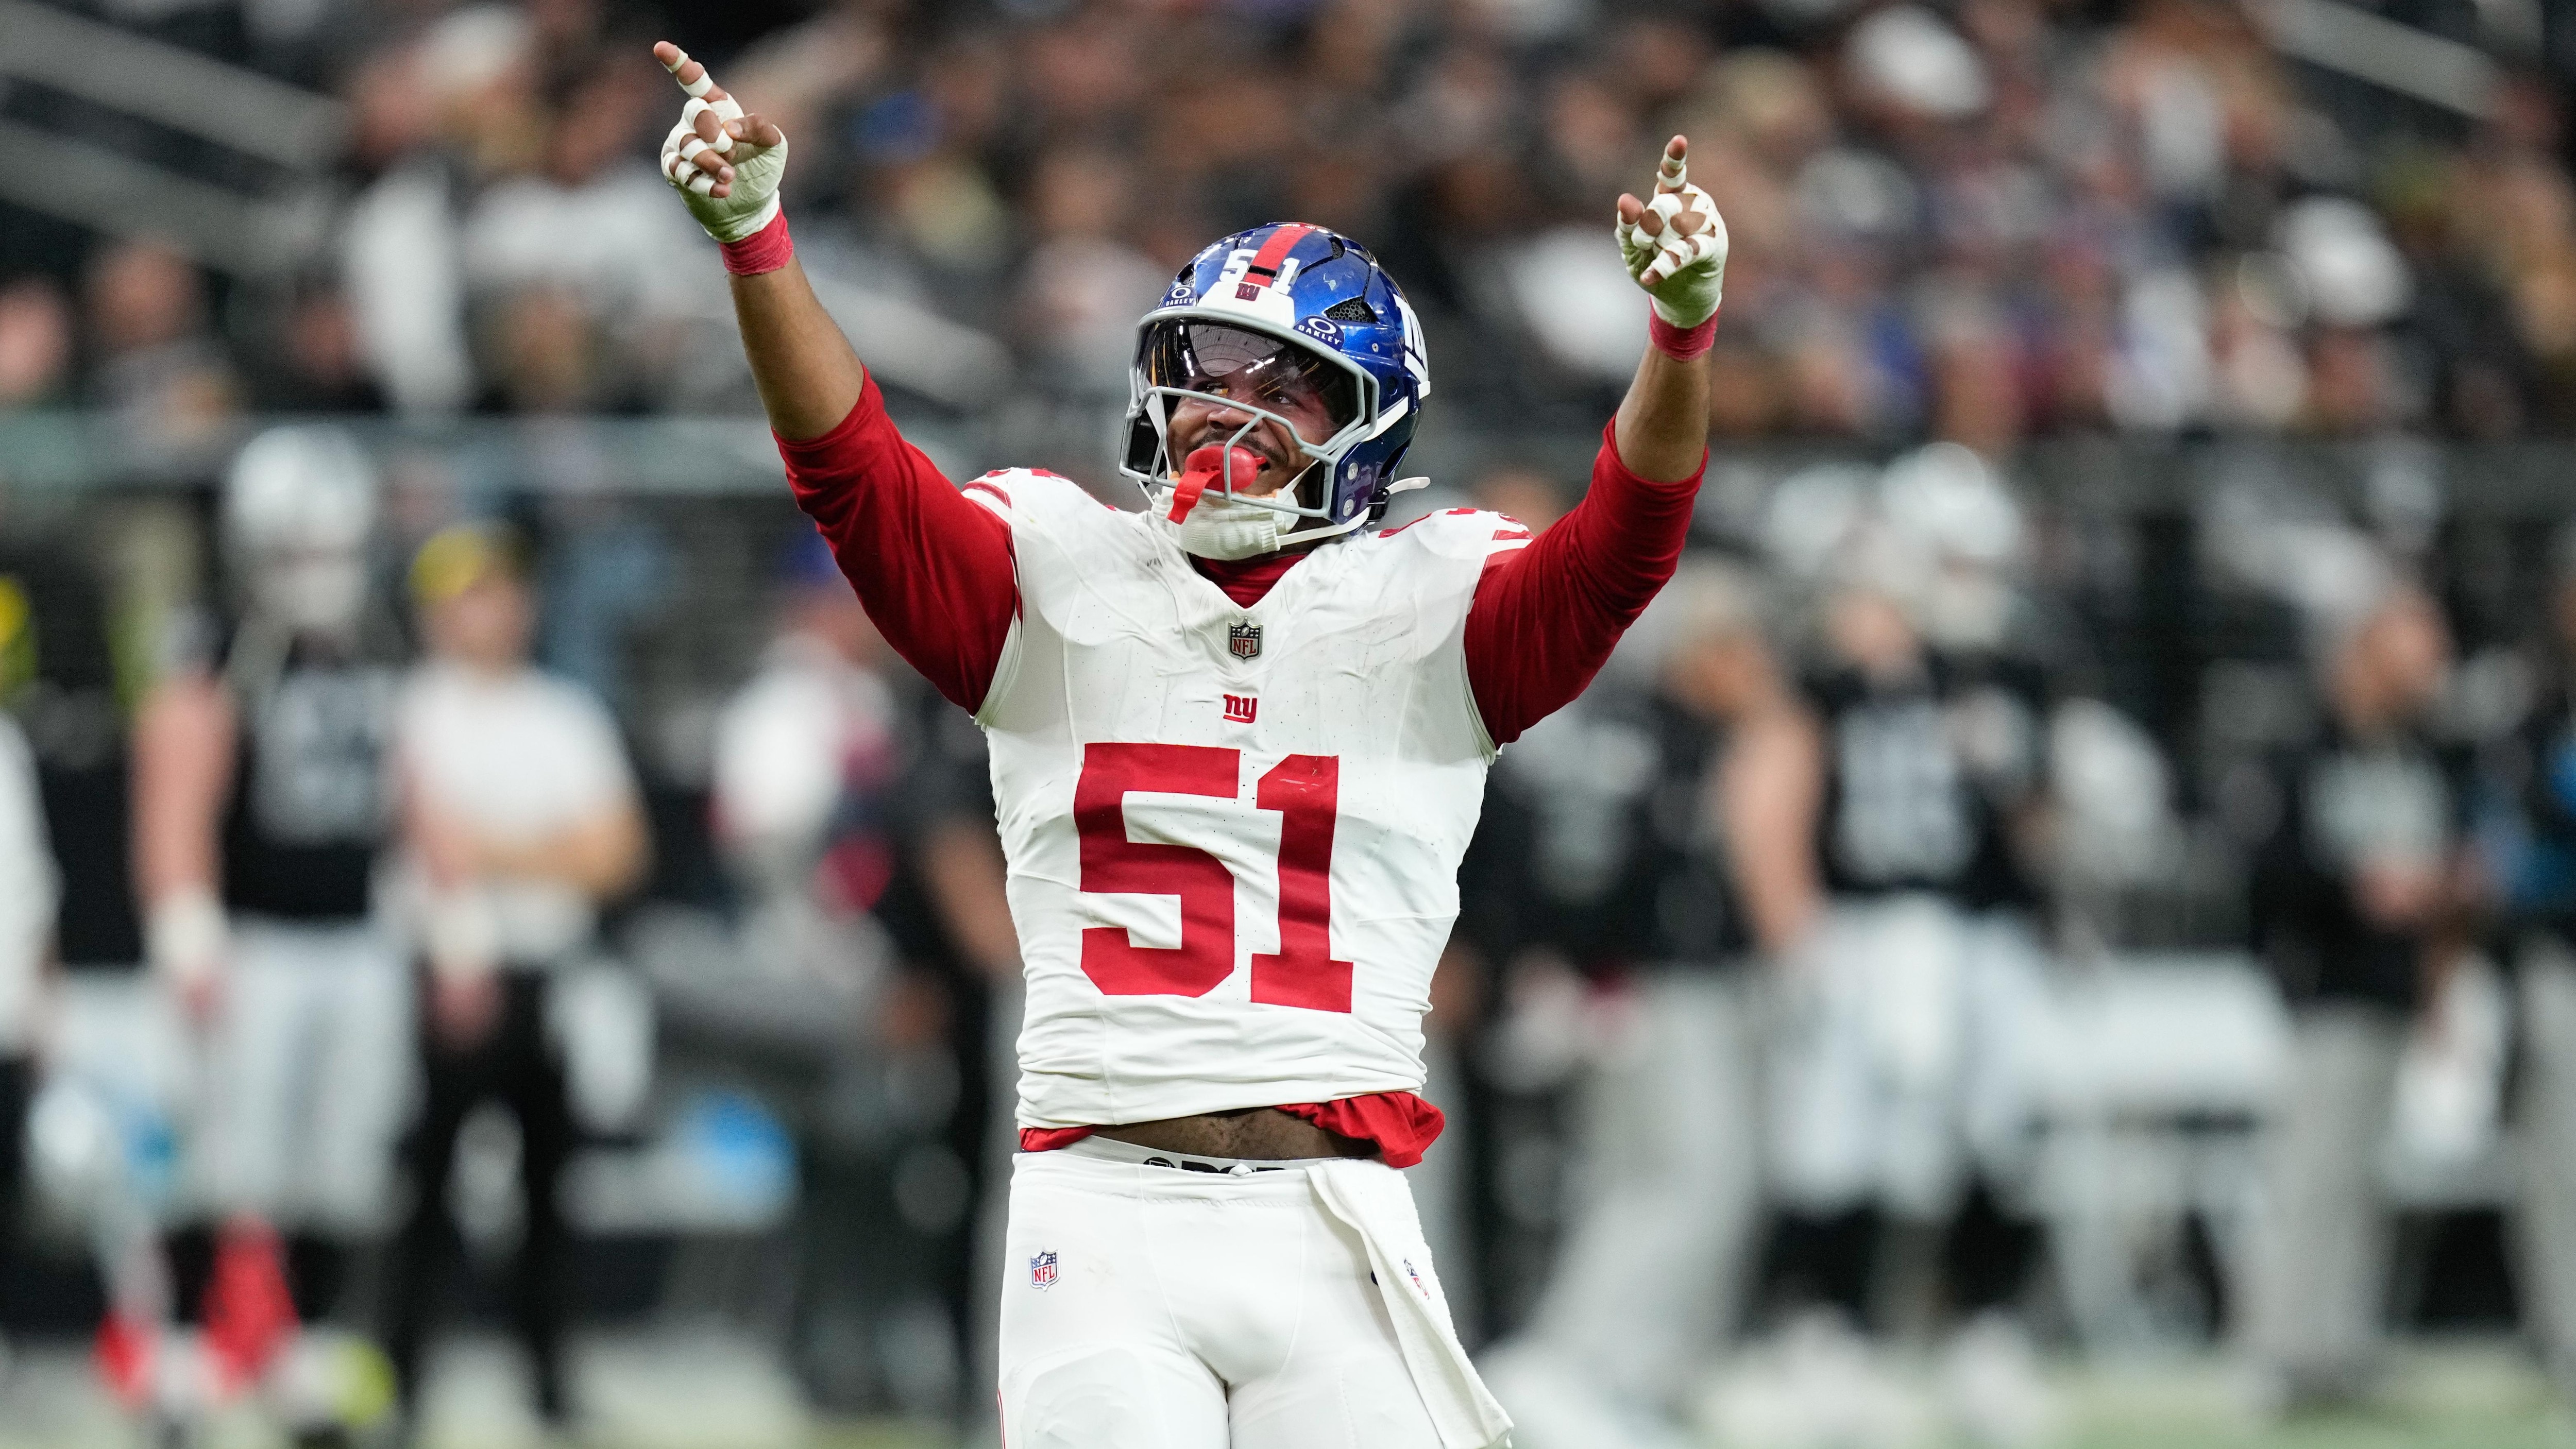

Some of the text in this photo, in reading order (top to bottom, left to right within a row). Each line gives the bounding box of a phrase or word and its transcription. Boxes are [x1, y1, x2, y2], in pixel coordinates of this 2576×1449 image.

[1219, 249, 1300, 295] 51
[1165, 298, 1194, 306] OAKLEY
[1298, 325, 1340, 345] OAKLEY
[1233, 638, 1257, 655] NFL
[1223, 694, 1258, 724] ny
[1074, 742, 1353, 1013] 51
[1033, 1265, 1055, 1282] NFL
